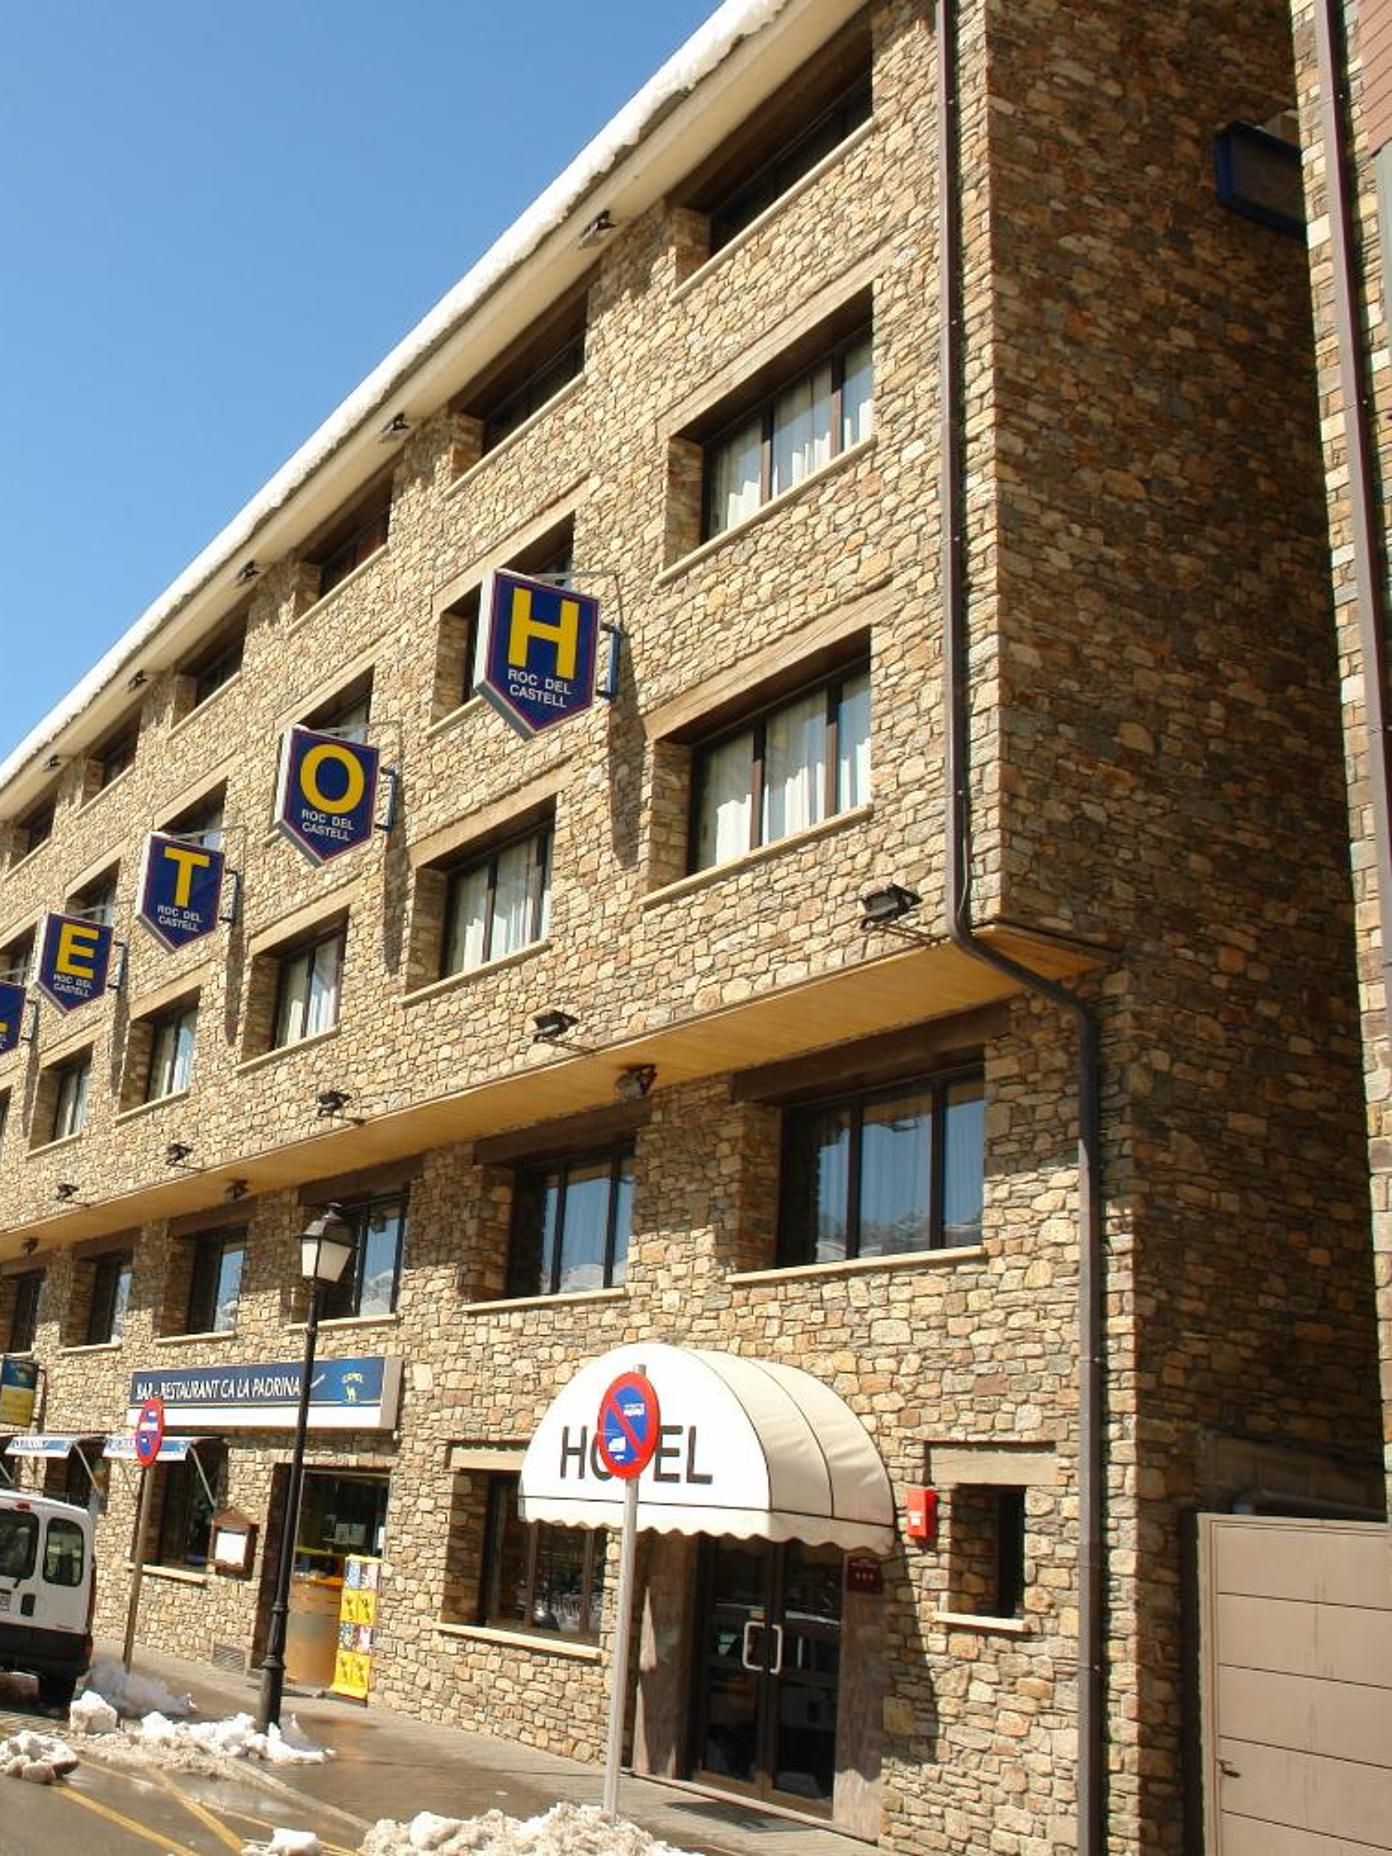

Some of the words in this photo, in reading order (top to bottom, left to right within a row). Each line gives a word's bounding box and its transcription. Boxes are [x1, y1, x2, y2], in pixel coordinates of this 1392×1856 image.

[508, 586, 580, 680] H
[508, 668, 538, 687] ROC
[545, 678, 572, 695] DEL
[509, 684, 567, 708] CASTELL
[300, 743, 365, 814] O
[301, 808, 327, 823] ROC
[331, 816, 354, 830] DEL
[301, 821, 351, 841] CASTELL
[164, 846, 210, 908] T
[157, 904, 180, 917] ROC
[183, 911, 203, 923] DEL
[158, 915, 199, 932] CASTELL
[56, 922, 99, 979] E
[53, 973, 74, 985] ROC
[53, 983, 90, 997] CASTELL
[136, 1381, 153, 1400] BAR
[160, 1379, 220, 1400] RESTAURANT
[220, 1377, 235, 1397] CA
[237, 1377, 250, 1397] LA
[251, 1375, 302, 1397] PADRINA
[560, 1425, 714, 1484] HOEL
